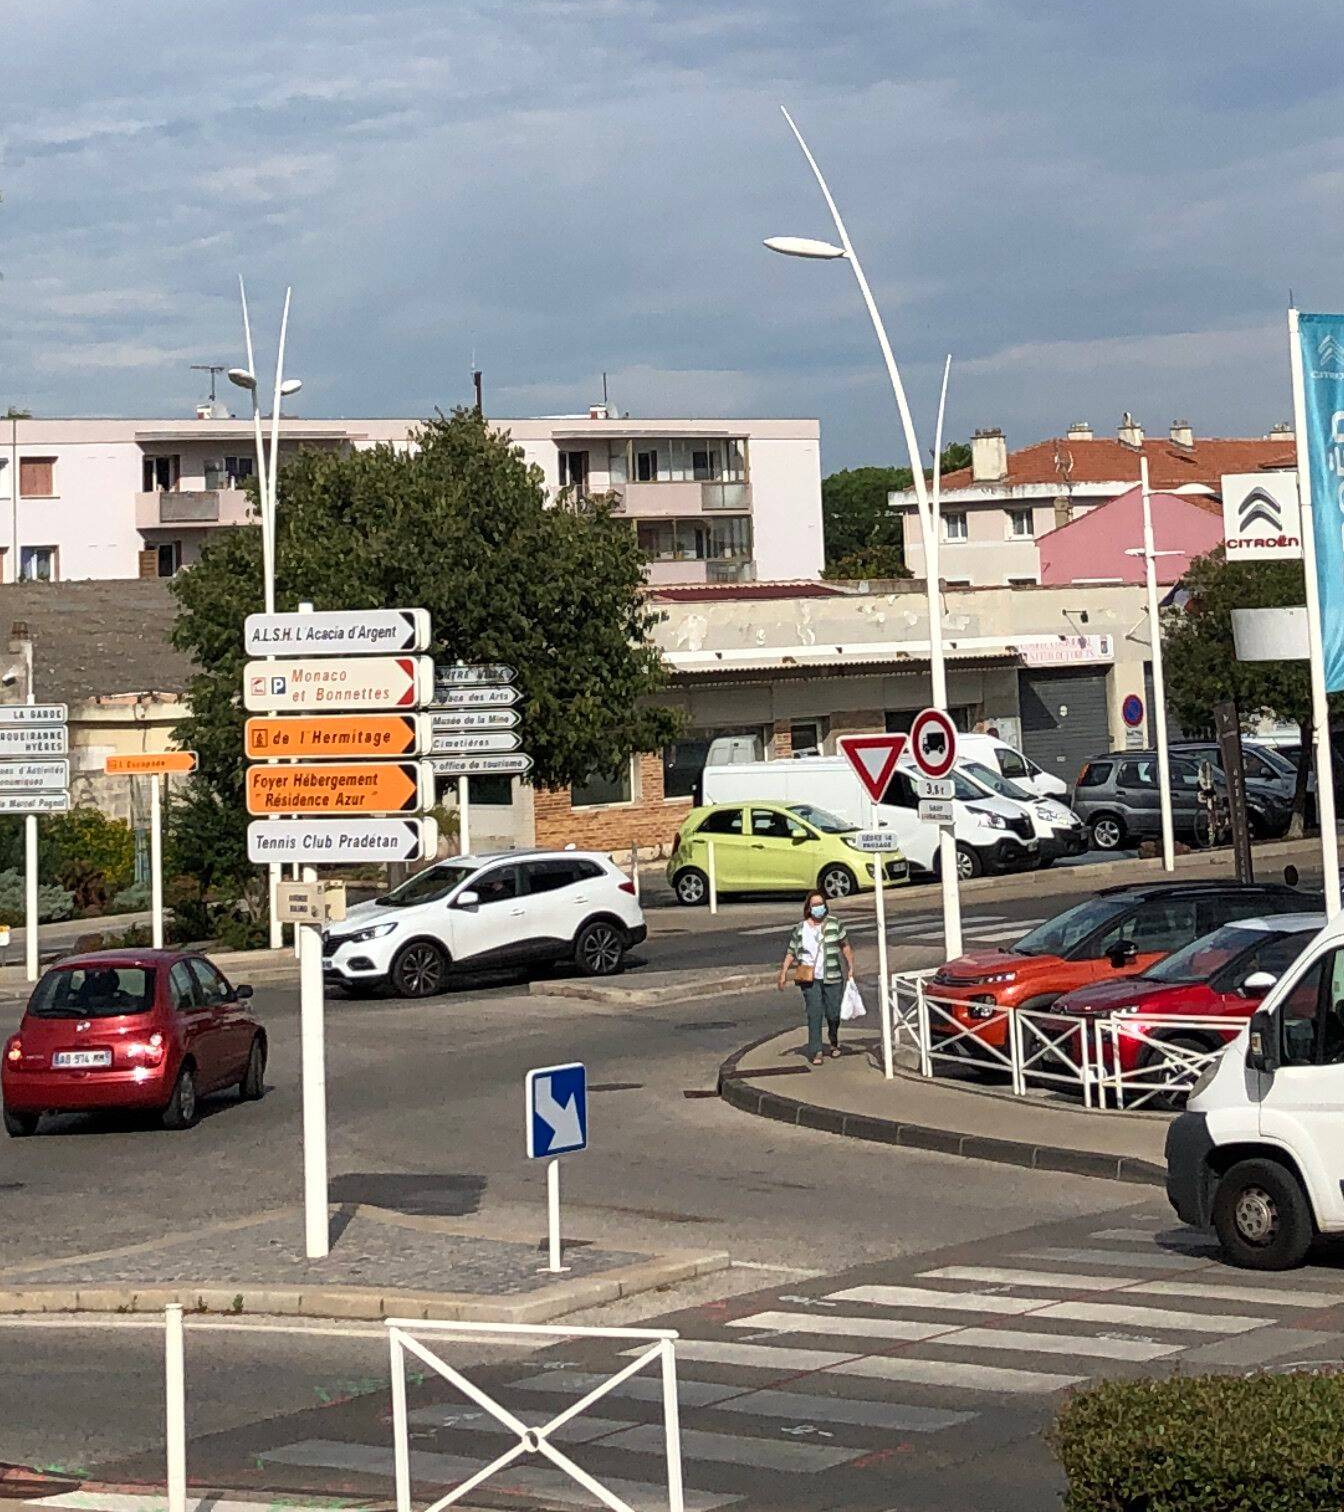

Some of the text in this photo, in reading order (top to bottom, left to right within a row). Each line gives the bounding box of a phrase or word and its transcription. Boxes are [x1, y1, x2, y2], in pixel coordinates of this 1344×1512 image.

[1226, 535, 1299, 549] CITROËN
[291, 669, 347, 683] Monaco
[292, 687, 390, 702] et Bonnettes
[489, 691, 508, 700] Arts
[14, 710, 62, 719] LA GARDE
[464, 716, 474, 724] de
[272, 730, 289, 745] de
[469, 760, 479, 769] de
[483, 759, 522, 769] tourisme
[253, 773, 378, 790] Foyer Hébergement
[256, 832, 398, 849] Tennis Club Pradétan
